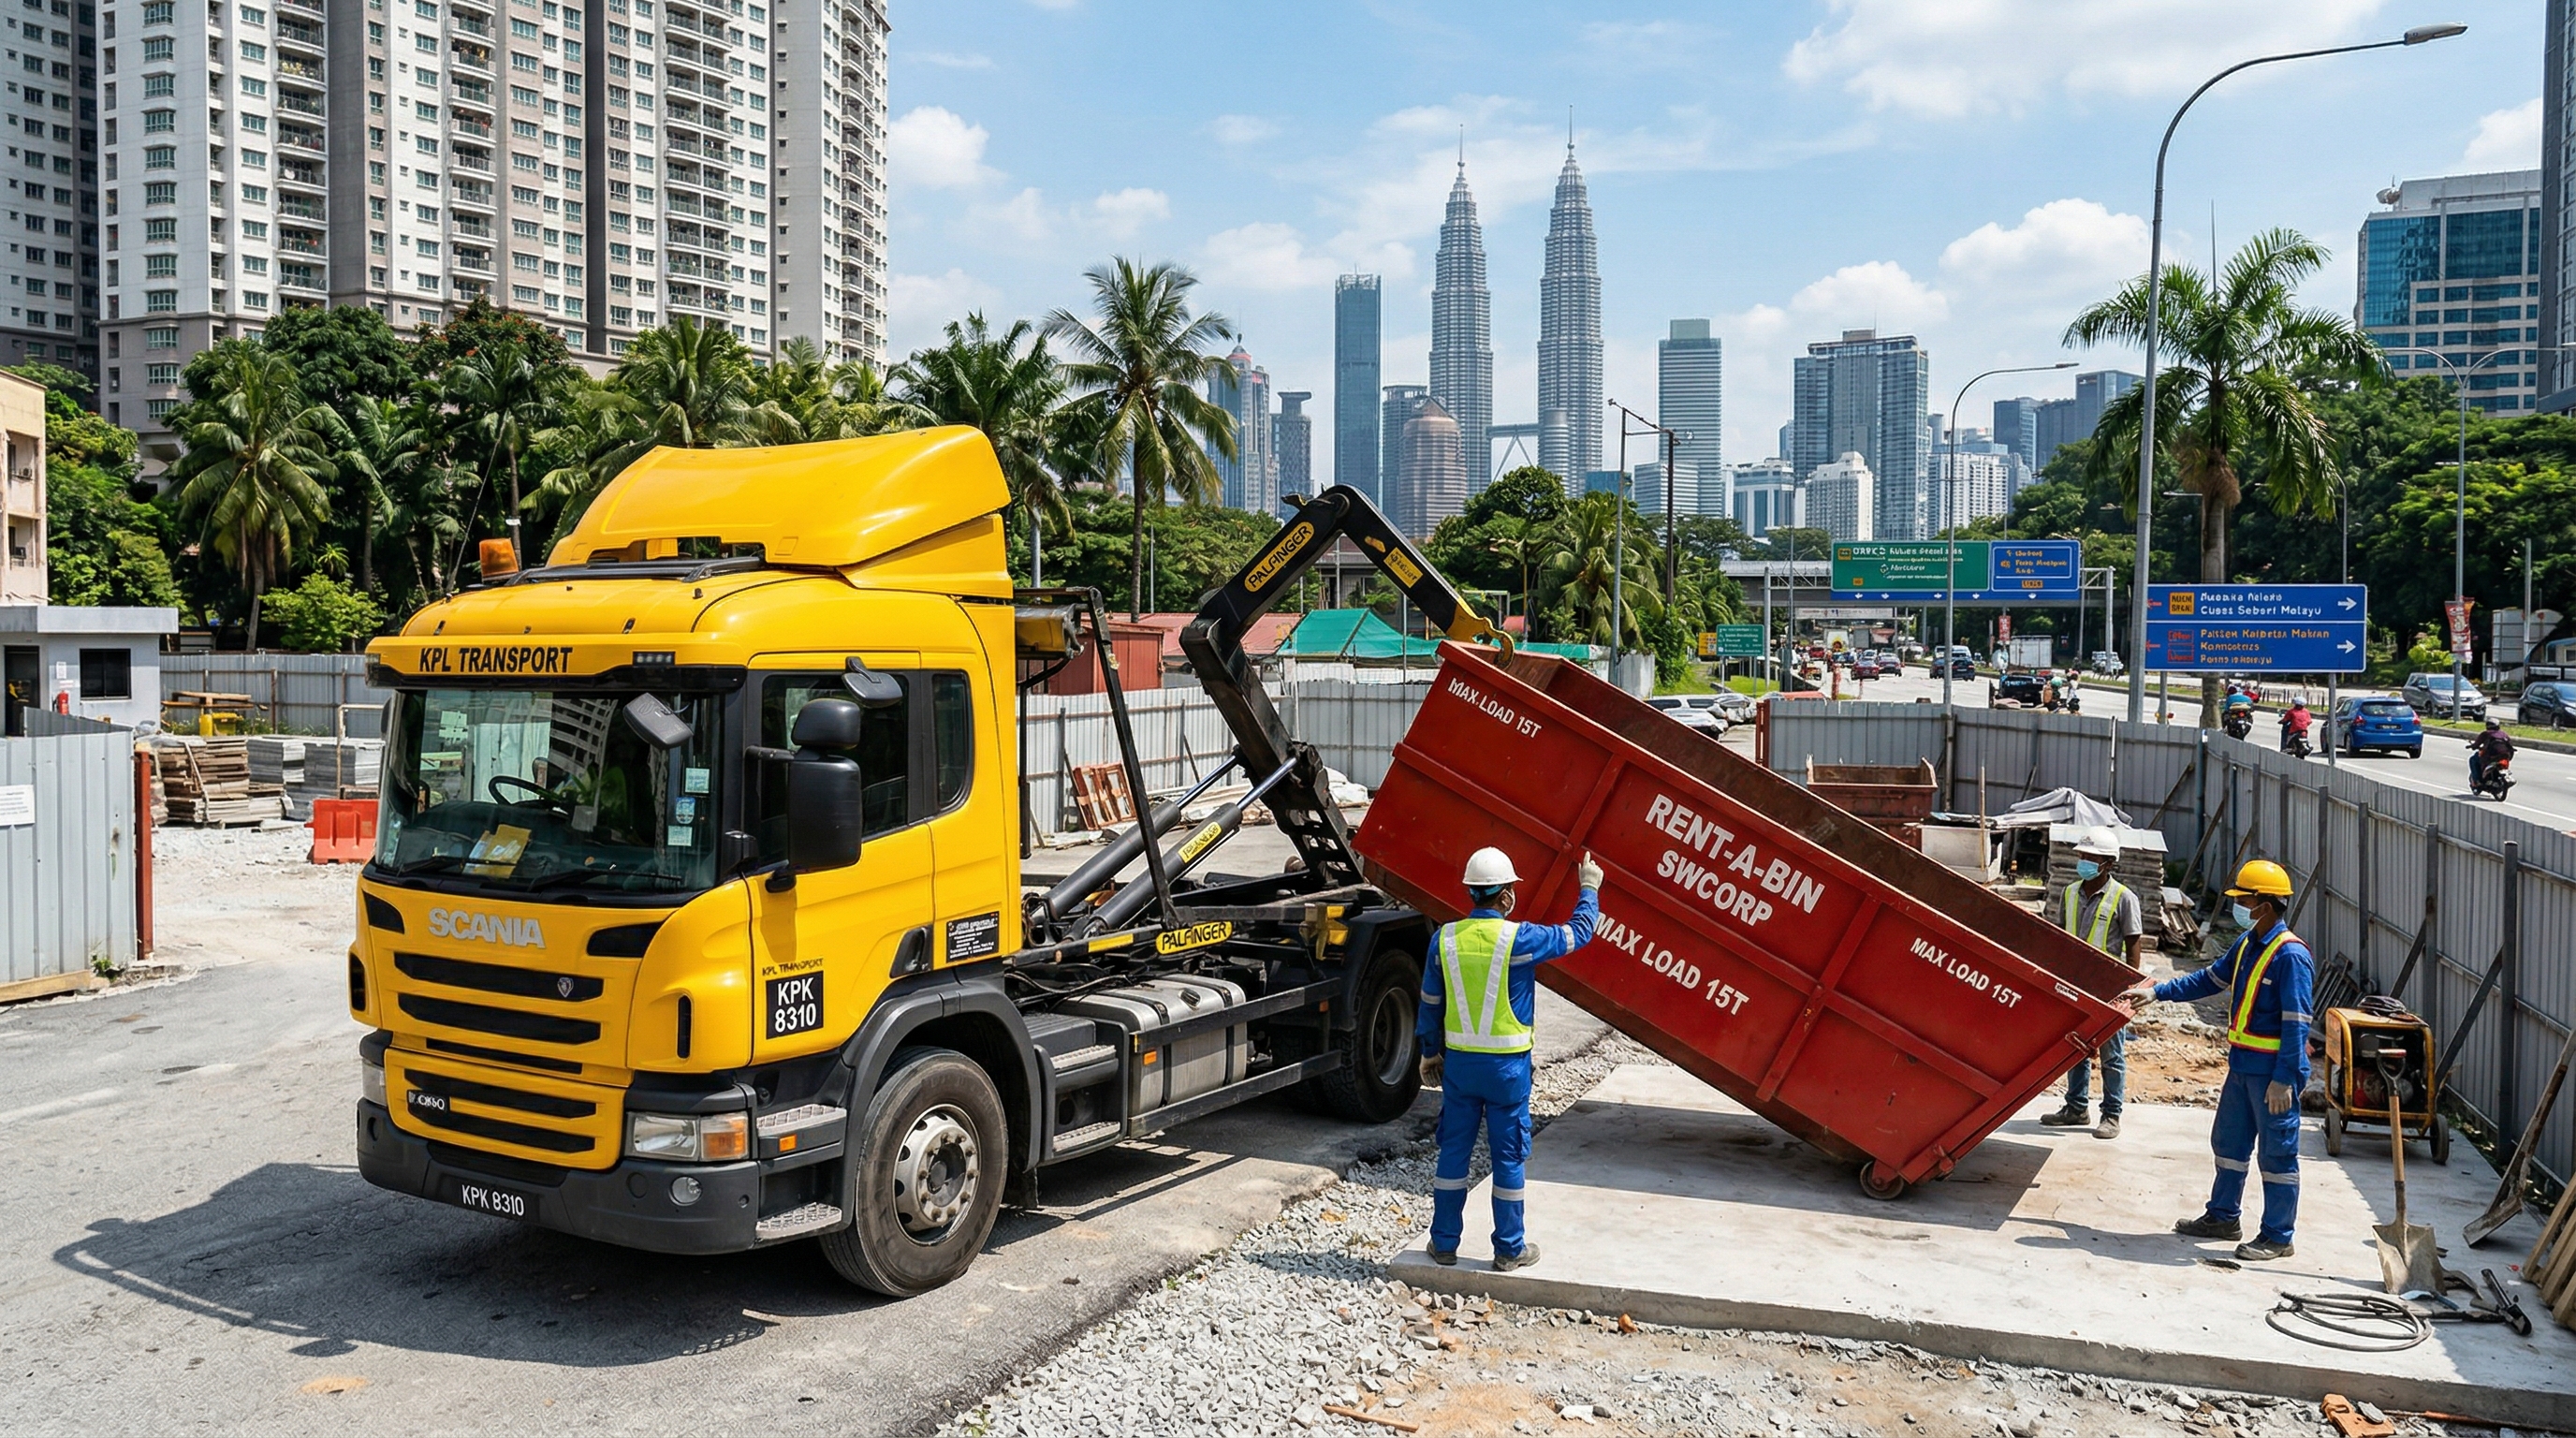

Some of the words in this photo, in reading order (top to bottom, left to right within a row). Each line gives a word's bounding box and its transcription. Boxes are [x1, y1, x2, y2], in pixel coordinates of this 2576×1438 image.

[419, 647, 451, 672] KPL
[459, 646, 573, 673] TRANSPORT
[1516, 715, 1543, 739] 15T
[1645, 793, 1825, 914] RENT-A-BIN
[1657, 849, 1773, 927] SWCORP
[428, 907, 546, 949] SCANIA
[1592, 912, 1644, 956] MAX
[1641, 942, 1702, 990] LOAD
[1705, 978, 1749, 1016] 15T
[1910, 937, 1949, 968] MAX
[1946, 958, 1990, 991] LOAD
[1991, 983, 2022, 1008] 15T
[777, 976, 814, 1006] KPK
[774, 1003, 817, 1033] 8310
[461, 1183, 490, 1210] KPK
[491, 1191, 524, 1216] 8310
